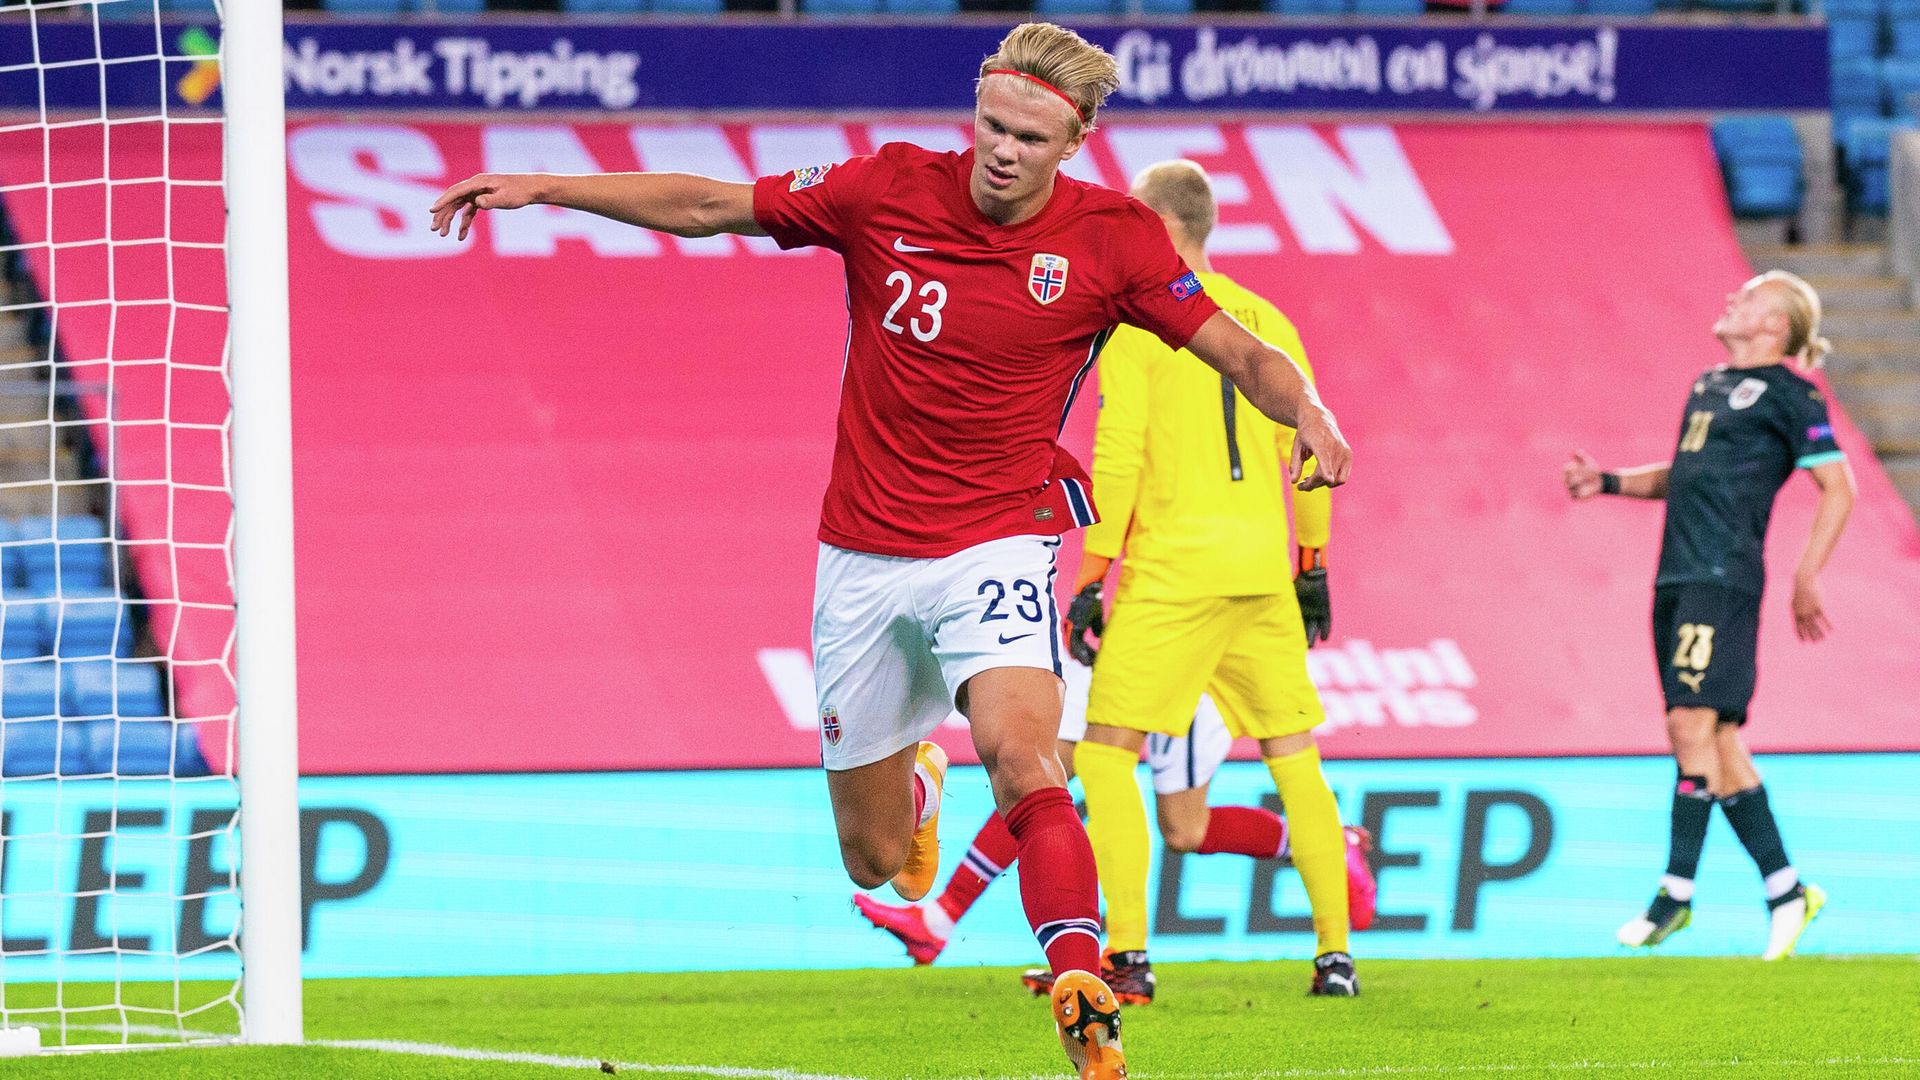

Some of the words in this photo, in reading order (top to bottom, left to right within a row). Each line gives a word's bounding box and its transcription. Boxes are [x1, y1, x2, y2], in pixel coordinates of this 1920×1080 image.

[284, 38, 434, 96] Norsk
[434, 38, 641, 108] Tipping
[1386, 41, 1448, 95] en
[1452, 27, 1619, 112] sjanse!
[289, 125, 1455, 258] SAMEN
[882, 270, 948, 342] 23
[978, 578, 1043, 625] 23
[1672, 623, 1715, 670] 23
[1076, 790, 1555, 936] LEEP
